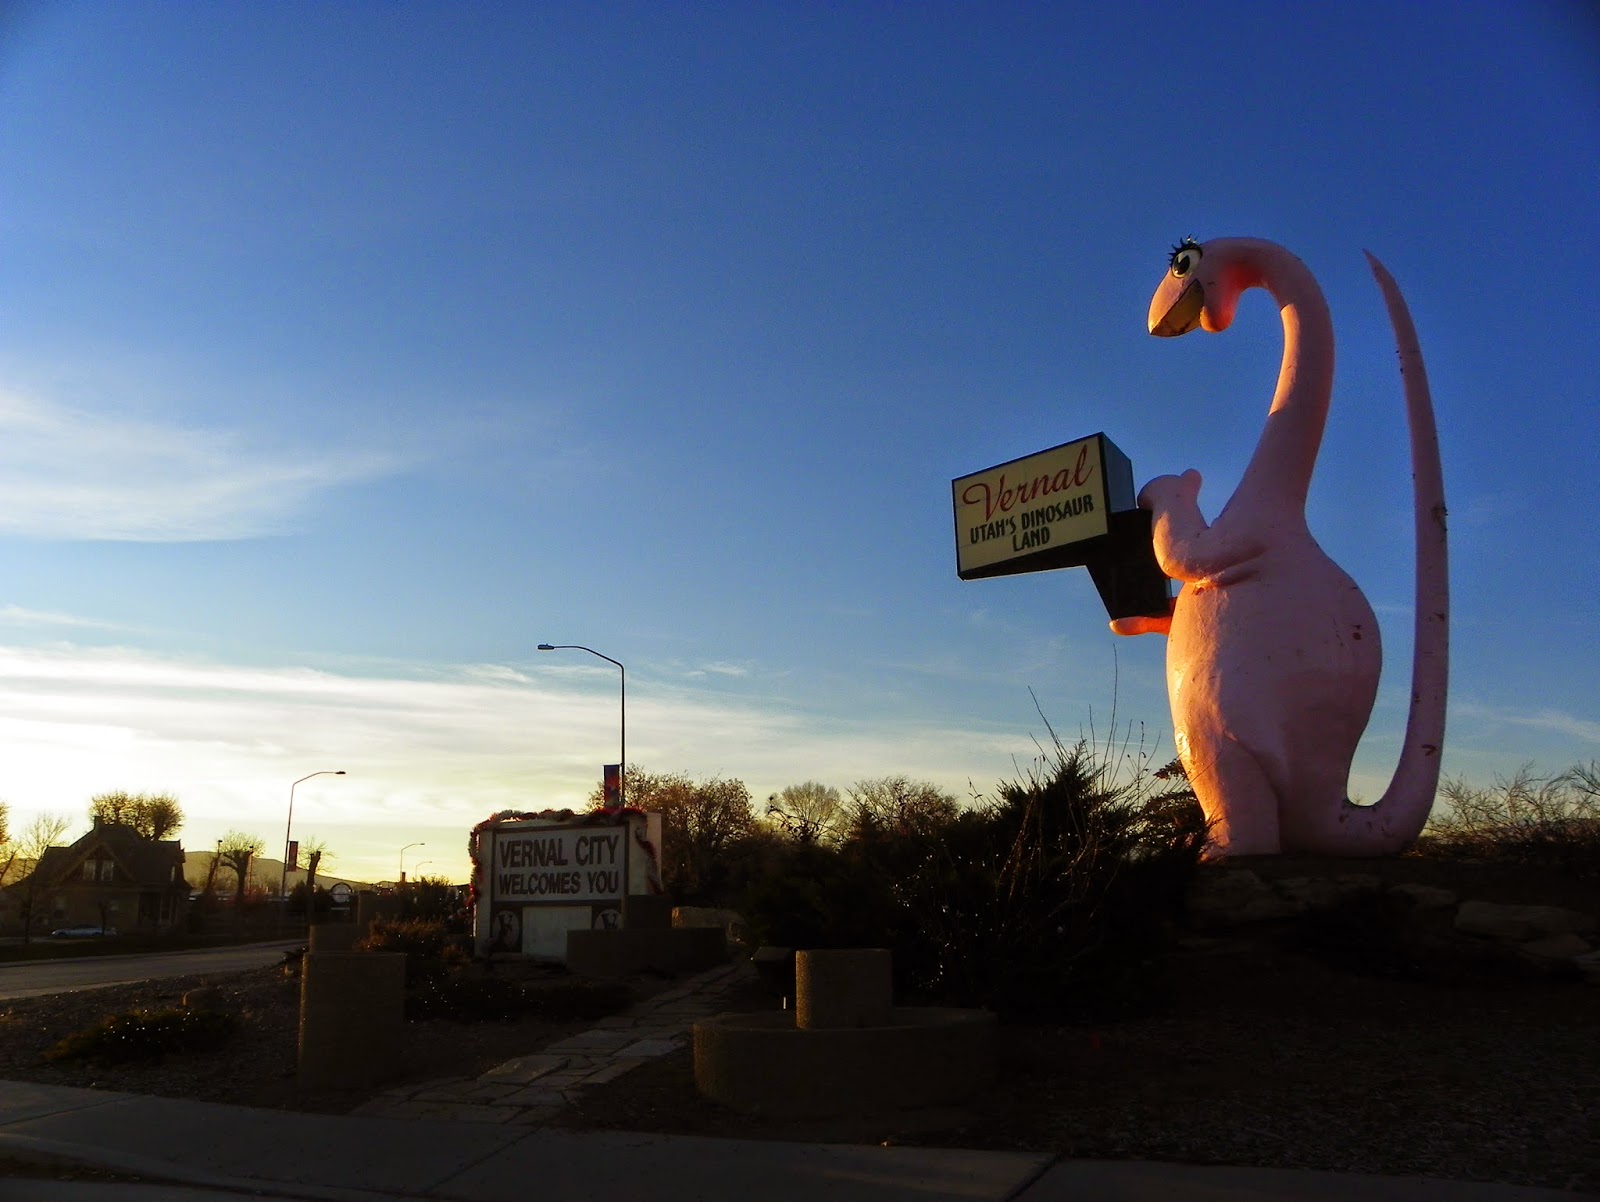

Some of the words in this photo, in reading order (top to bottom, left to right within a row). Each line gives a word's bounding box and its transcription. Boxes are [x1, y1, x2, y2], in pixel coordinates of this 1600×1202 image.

[962, 444, 1093, 522] Vernal
[970, 515, 1016, 544] UTAH'S
[1021, 494, 1094, 529] DINOSAUR
[1012, 527, 1050, 551] LAND
[500, 838, 568, 868] VERNAL
[575, 835, 619, 866] CITY
[500, 871, 581, 895] WELCOMES
[588, 870, 618, 893] YOU
